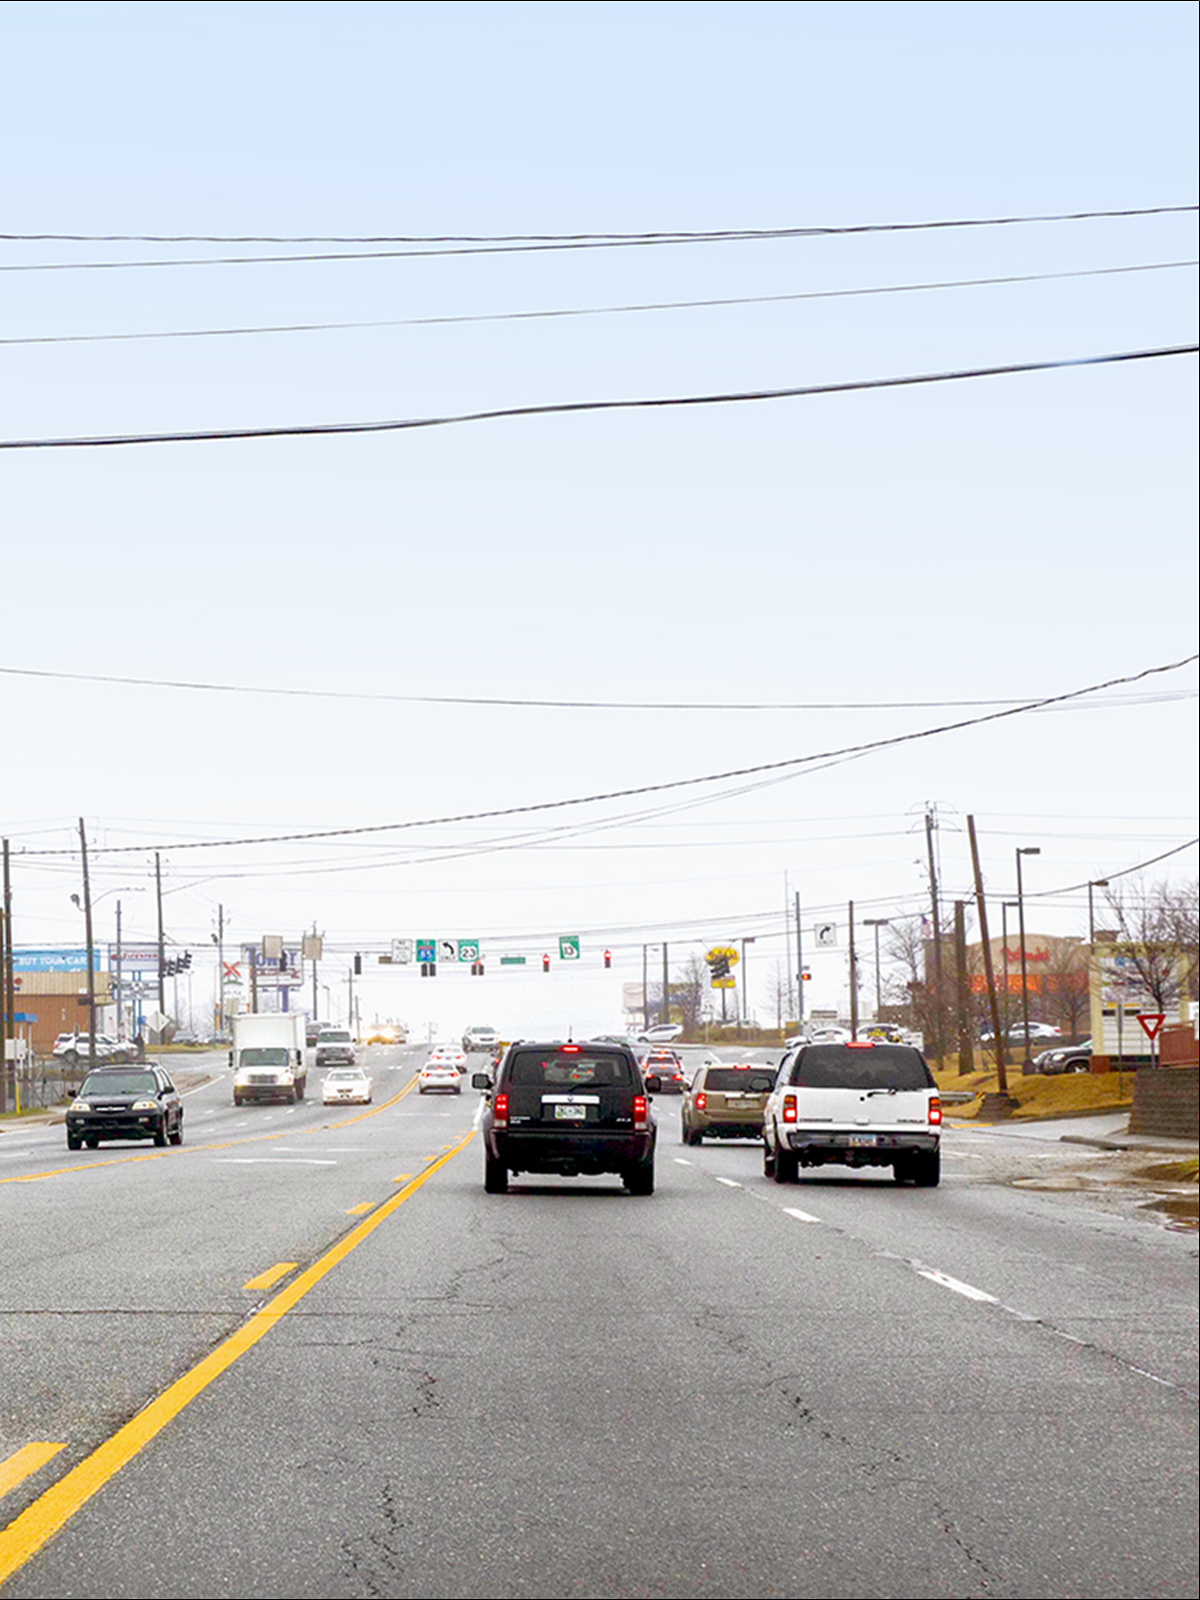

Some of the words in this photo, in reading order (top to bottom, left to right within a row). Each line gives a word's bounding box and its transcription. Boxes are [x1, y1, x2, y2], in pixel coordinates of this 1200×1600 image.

[462, 948, 476, 958] 23
[19, 957, 37, 965] BUY
[39, 956, 65, 965] YOUR
